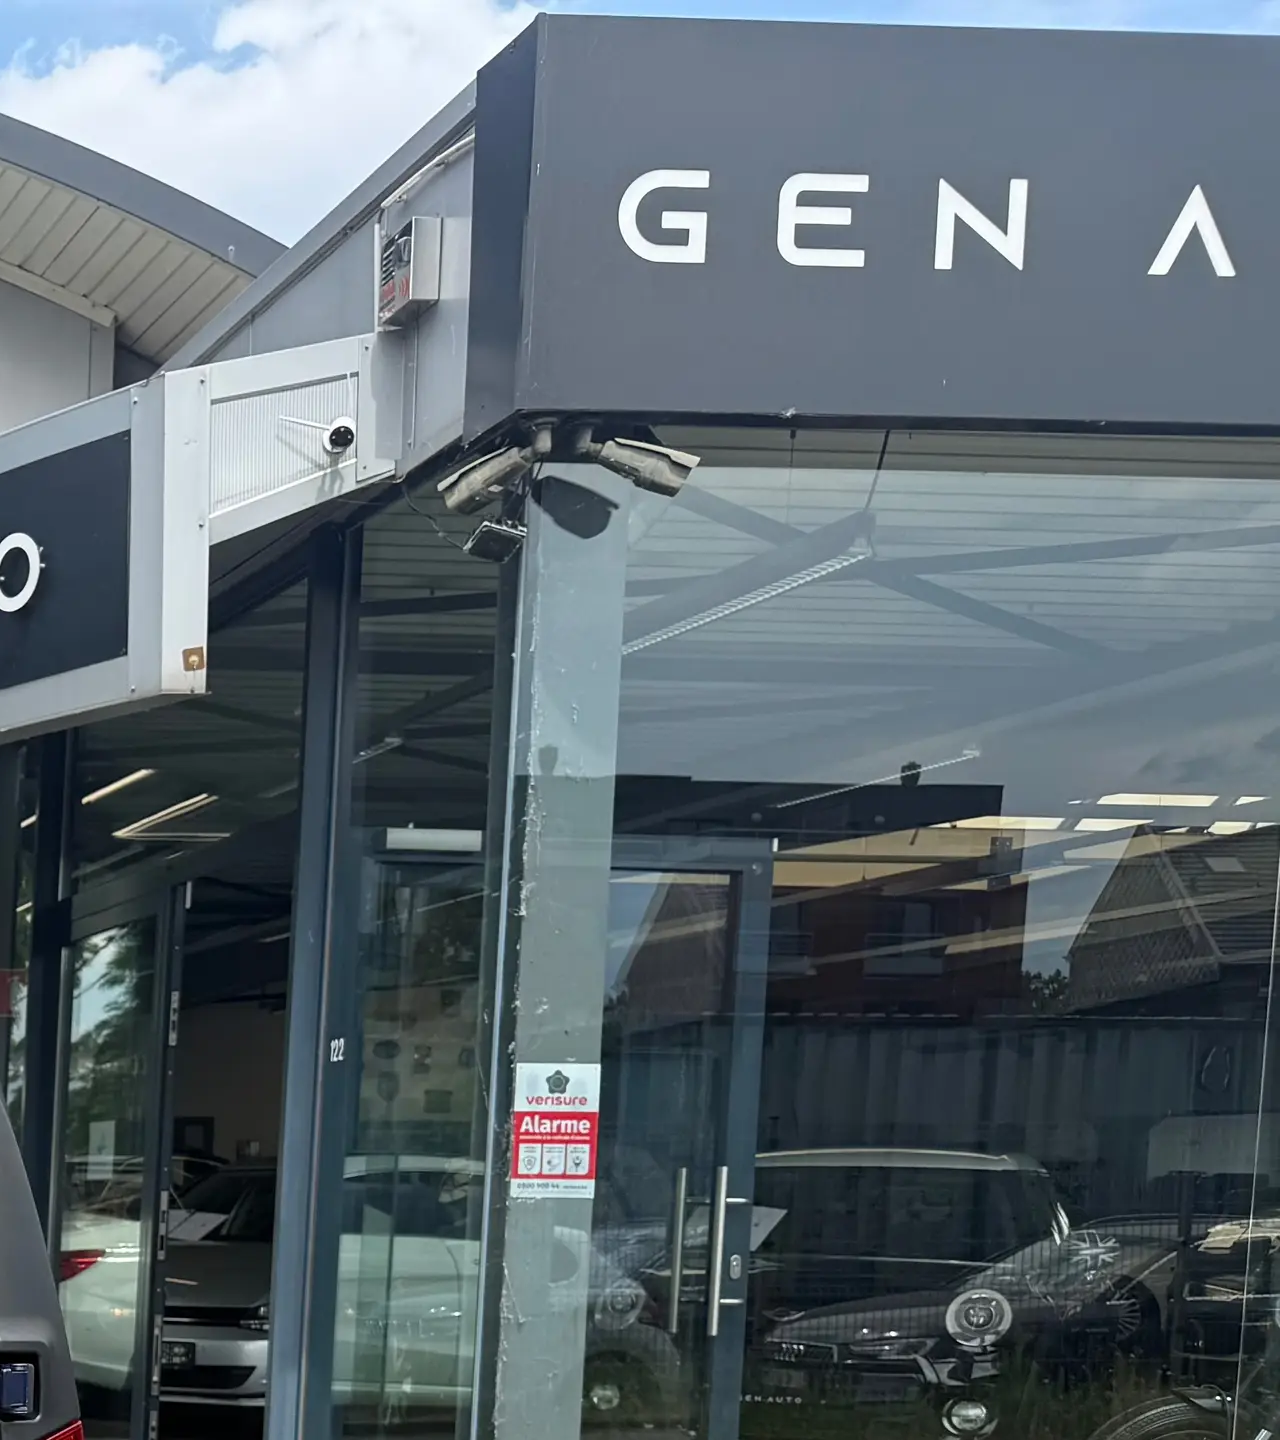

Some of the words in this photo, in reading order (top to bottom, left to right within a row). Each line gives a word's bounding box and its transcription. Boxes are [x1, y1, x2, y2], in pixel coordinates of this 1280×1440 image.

[618, 169, 1030, 271] GEN
[330, 1037, 345, 1062] 122
[526, 1096, 588, 1106] verisure
[520, 1114, 591, 1134] Alarme
[766, 1396, 803, 1404] AUTO
